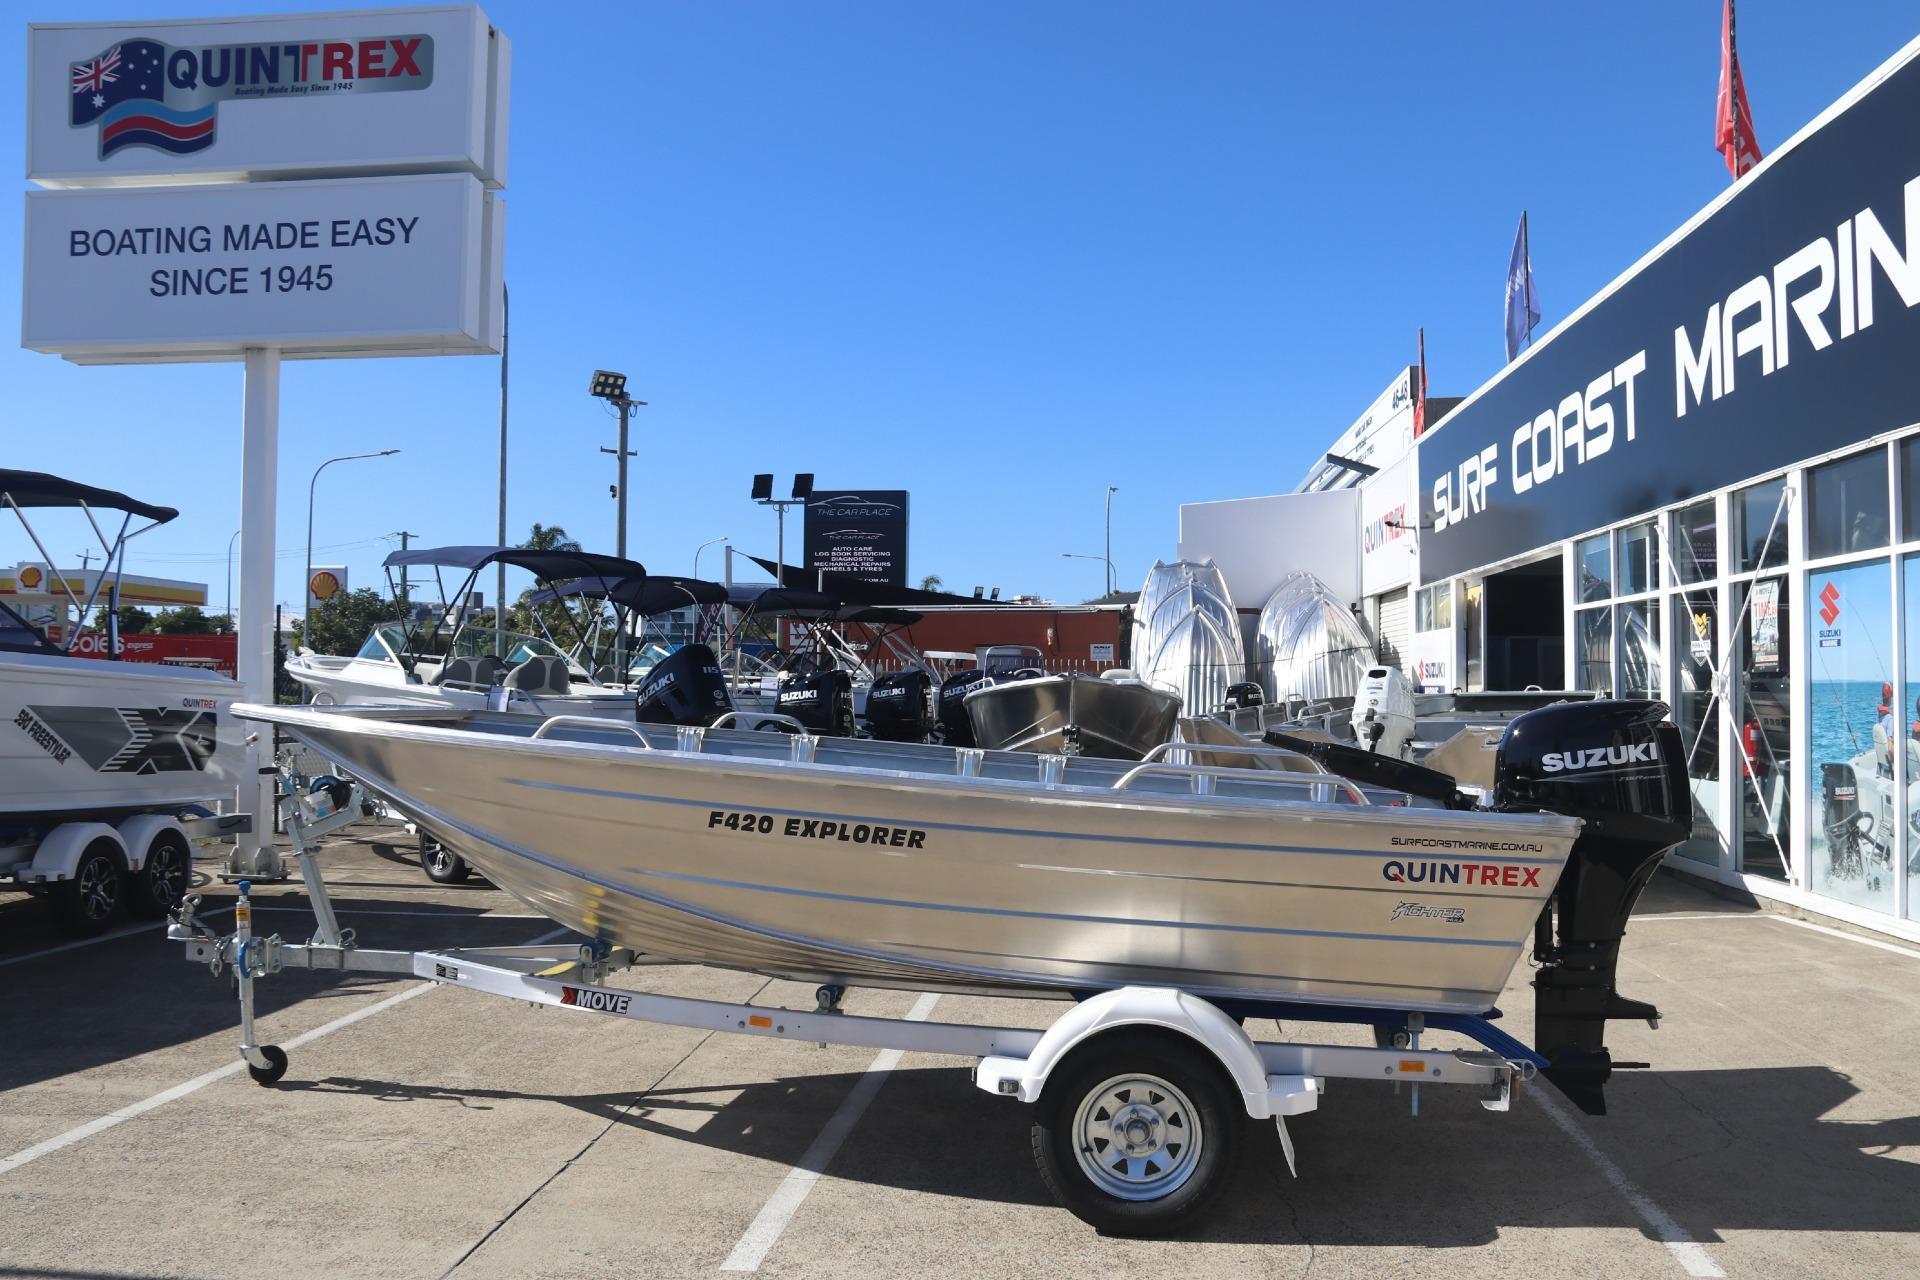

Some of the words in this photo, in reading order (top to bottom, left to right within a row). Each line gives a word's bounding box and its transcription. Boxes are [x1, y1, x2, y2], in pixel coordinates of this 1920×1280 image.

[167, 38, 422, 91] QUINTREX
[267, 84, 289, 94] Made
[310, 82, 331, 92] Since
[333, 82, 353, 91] 1945
[69, 226, 212, 257] BOATING
[222, 221, 320, 252] MADE
[329, 217, 420, 248] EASY
[149, 267, 249, 297] SINCE
[259, 265, 334, 293] 1945
[1433, 442, 1498, 534] SURF
[1511, 349, 1646, 495] COAST
[816, 508, 836, 516] THE
[837, 508, 858, 516] CAR
[859, 508, 893, 516] PLACE
[1364, 503, 1406, 555] QUINTREX
[1819, 629, 1841, 638] SUZUKI
[703, 666, 718, 674] 115
[1425, 661, 1446, 679] SUZUKI
[638, 672, 675, 706] SUZUKI
[780, 689, 817, 702] SUZUKI
[872, 687, 905, 699] SUZUKI
[182, 698, 217, 708] QUINTREX
[27, 720, 72, 765] FREESTYLER
[1541, 742, 1658, 773] SUZUKI
[708, 811, 774, 834] F420
[783, 818, 926, 848] EXPLORER
[1391, 837, 1543, 853] SURFCOASTMARINE.COM.AU
[1382, 860, 1541, 888] QUINTREX
[1391, 900, 1465, 921] FIGHTER
[576, 989, 629, 1014] MOVE
